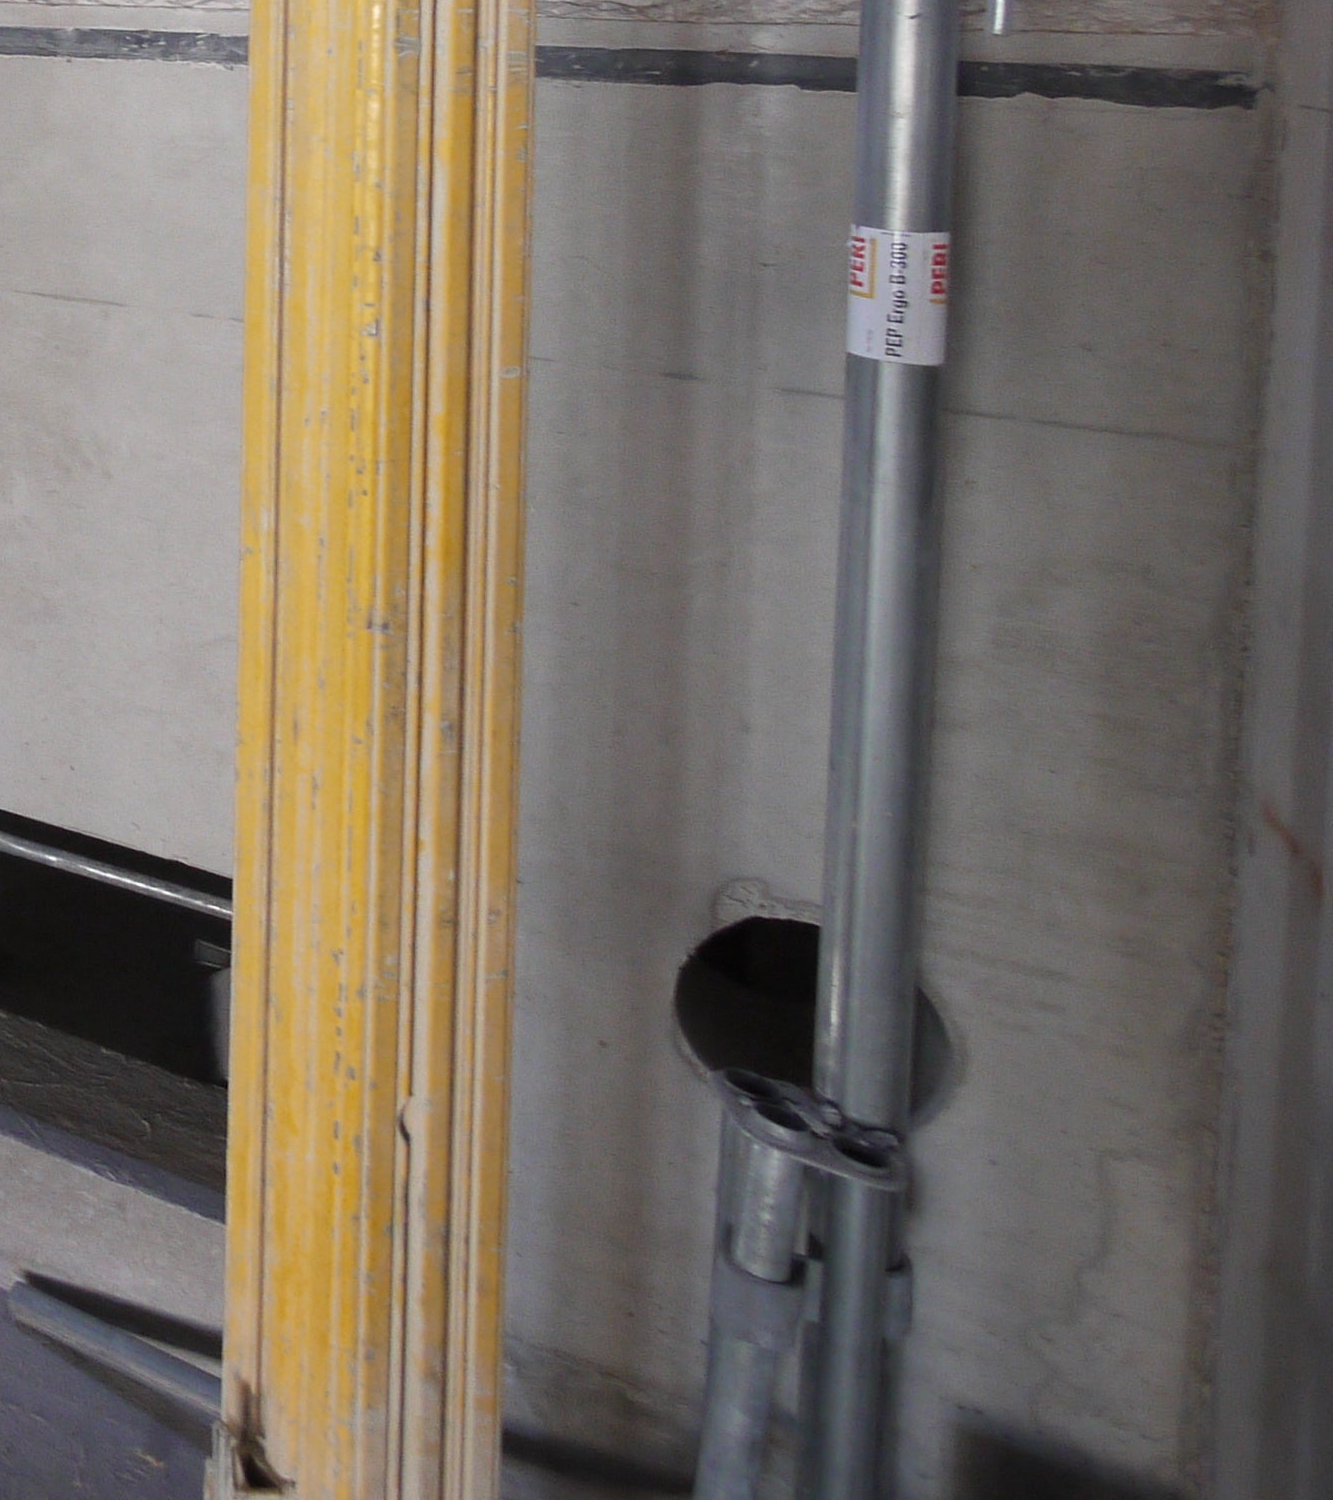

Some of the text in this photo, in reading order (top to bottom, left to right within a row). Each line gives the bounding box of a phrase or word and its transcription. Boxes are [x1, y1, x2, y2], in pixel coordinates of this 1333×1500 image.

[850, 235, 866, 288] PERI
[930, 243, 949, 295] PERI
[887, 289, 910, 324] Ergo
[885, 327, 904, 358] PEP
